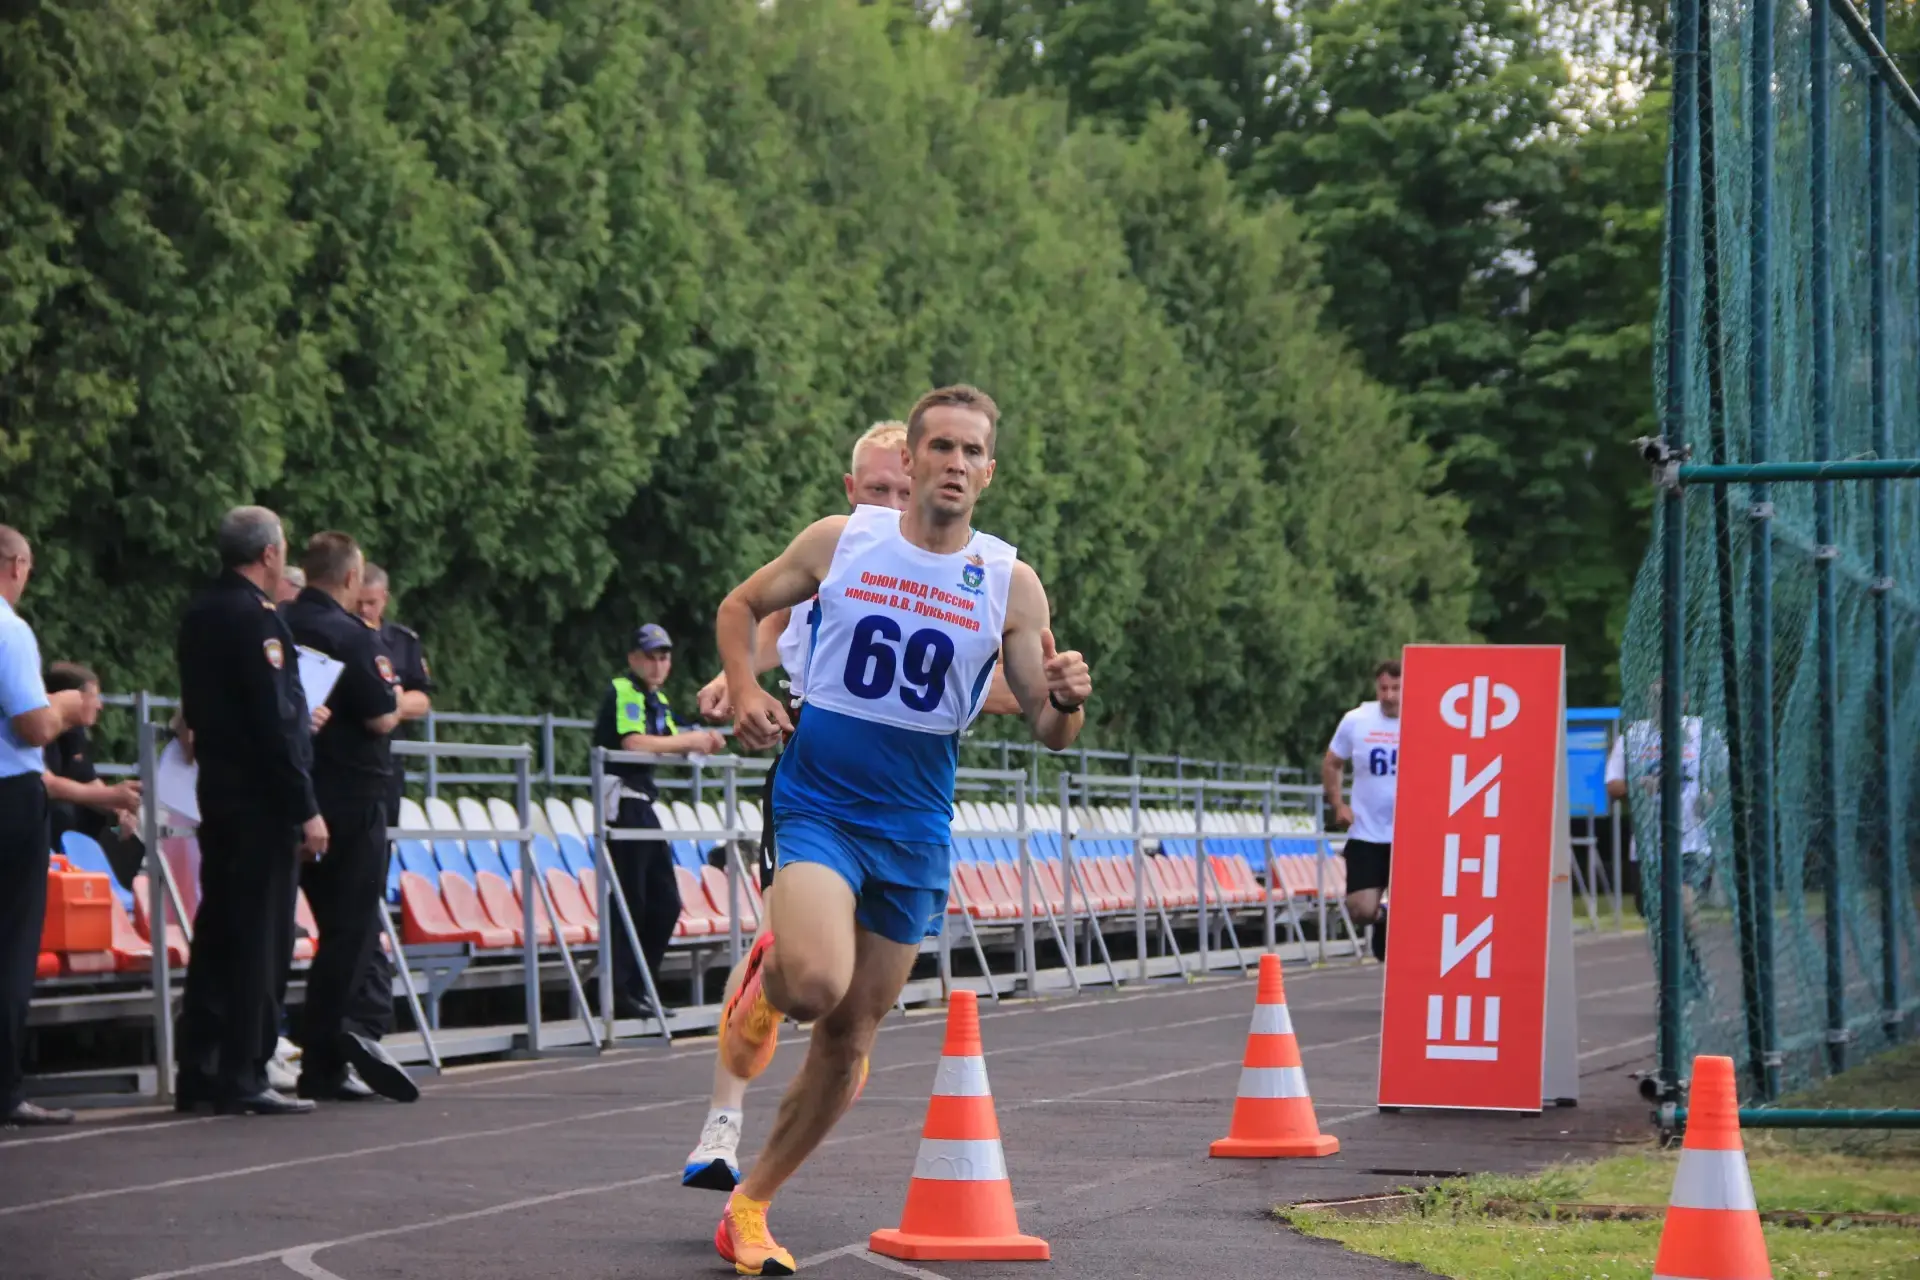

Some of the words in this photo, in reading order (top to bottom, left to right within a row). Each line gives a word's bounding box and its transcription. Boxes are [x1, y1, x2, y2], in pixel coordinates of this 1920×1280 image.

[844, 587, 888, 606] имени
[888, 594, 911, 612] В.В.
[913, 600, 980, 632] Лукьянова
[860, 571, 898, 590] ОрЮИ
[898, 579, 929, 600] МВД
[929, 586, 975, 612] России
[843, 614, 954, 712] 69
[1425, 675, 1521, 1061] ФИНИШ
